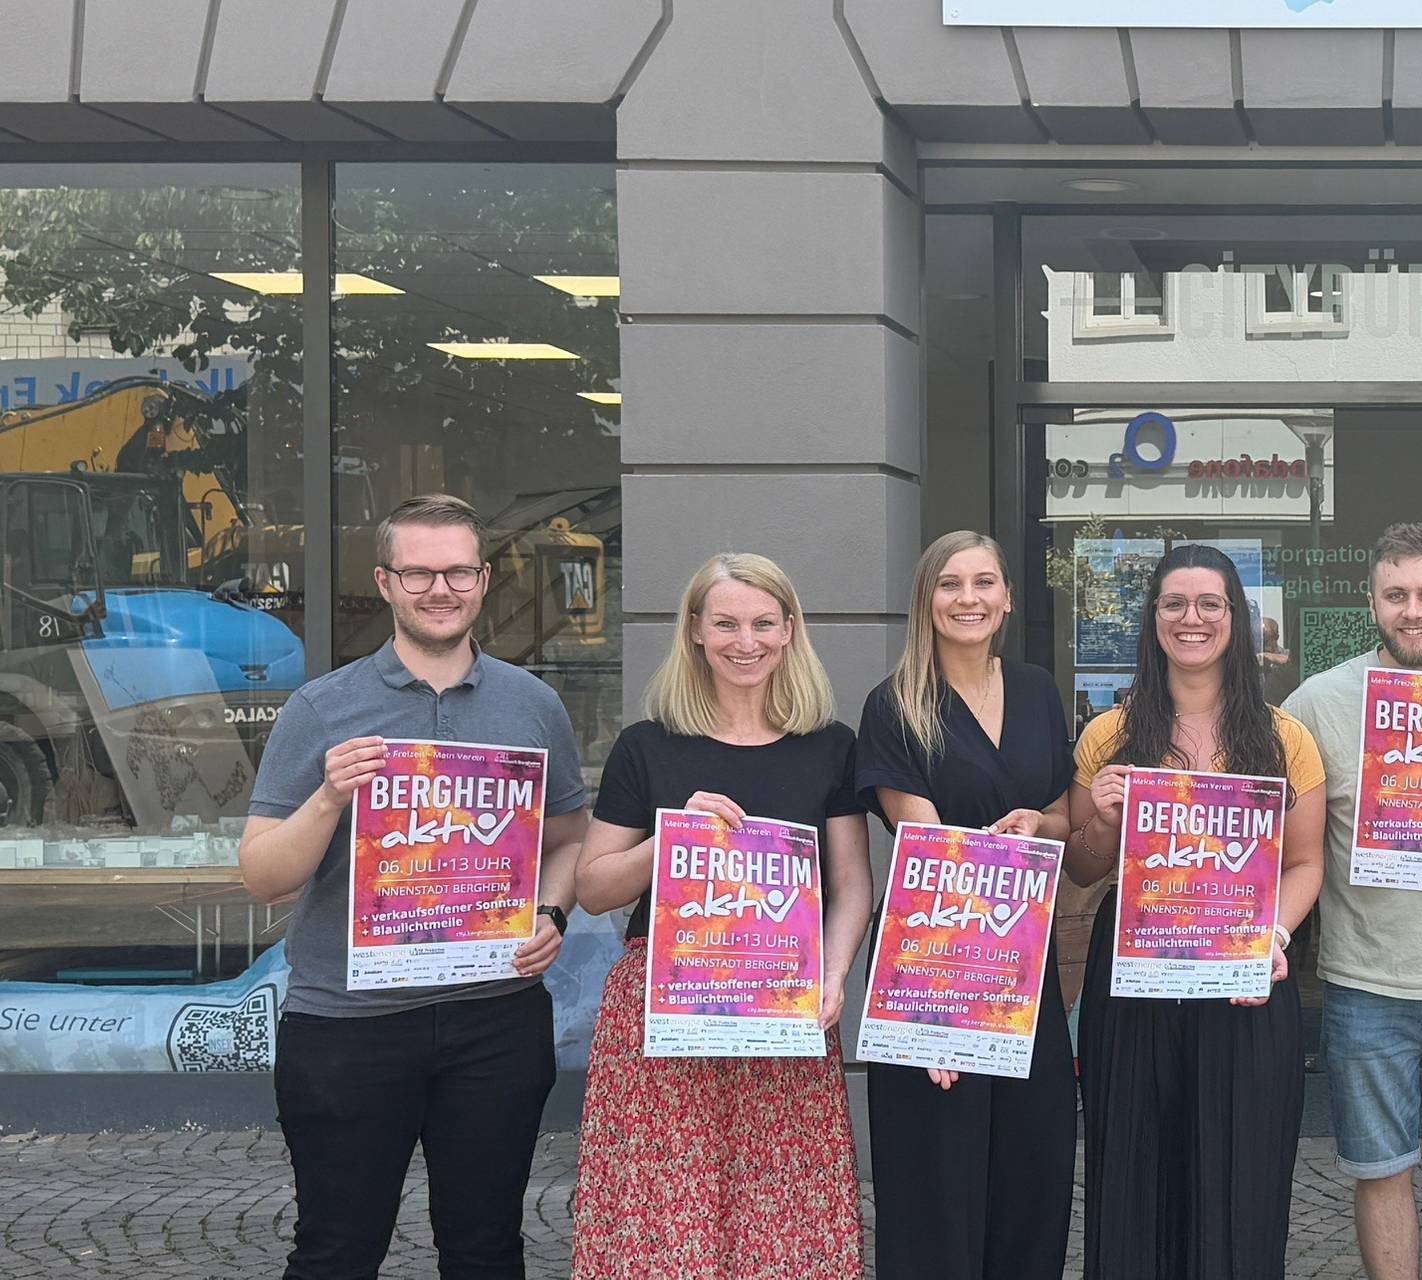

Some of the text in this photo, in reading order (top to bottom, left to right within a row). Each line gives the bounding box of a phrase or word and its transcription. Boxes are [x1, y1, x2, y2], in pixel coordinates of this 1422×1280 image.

[1381, 774, 1400, 786] 06.
[371, 775, 533, 810] BERGHEIM
[665, 820, 690, 828] Meine
[747, 828, 771, 836] Verein
[1137, 801, 1273, 839] BERGHEIM
[382, 809, 515, 849] aktiv
[904, 833, 926, 842] Meine
[962, 838, 981, 847] Mein
[983, 841, 1008, 850] Verein
[1145, 834, 1258, 873] aktiv
[379, 860, 403, 874] 06.
[475, 857, 511, 870] UHR
[670, 845, 811, 888] BERGHEIM
[378, 882, 510, 896] INNENSTADT BERGHEIM
[903, 857, 1048, 904] BERGHEIM
[1143, 880, 1163, 892] 06.
[1223, 884, 1255, 897] UHR
[372, 904, 472, 922] verkaufsoffener
[475, 898, 526, 910] Sonntag
[679, 881, 800, 923] aktiv
[907, 893, 1028, 937] aktiv
[1140, 905, 1253, 918] INNENSTADT BERGHEIM
[373, 918, 463, 936] Blaulichtmeile
[1135, 925, 1220, 935] verkaufsoffener
[1223, 924, 1267, 934] Sonntag
[676, 930, 699, 944] 06.
[766, 935, 799, 948] UHR
[1135, 938, 1212, 948] Blaulichtmeile
[901, 939, 922, 954] 06.
[986, 948, 1019, 964] UHR
[674, 958, 799, 971] INNENSTADT BERGHEIM
[896, 964, 1017, 986] INNENSTADT BERGHEIM
[668, 979, 762, 991] verkaufsoffener
[766, 978, 813, 989] Sonntag
[669, 994, 753, 1005] Blaulichtmeile
[887, 989, 979, 1001] verkaufsoffener
[982, 992, 1030, 1006] Sonntag
[886, 1000, 969, 1014] Blaulichtmeile
[0, 1007, 133, 1033] Sie unter
